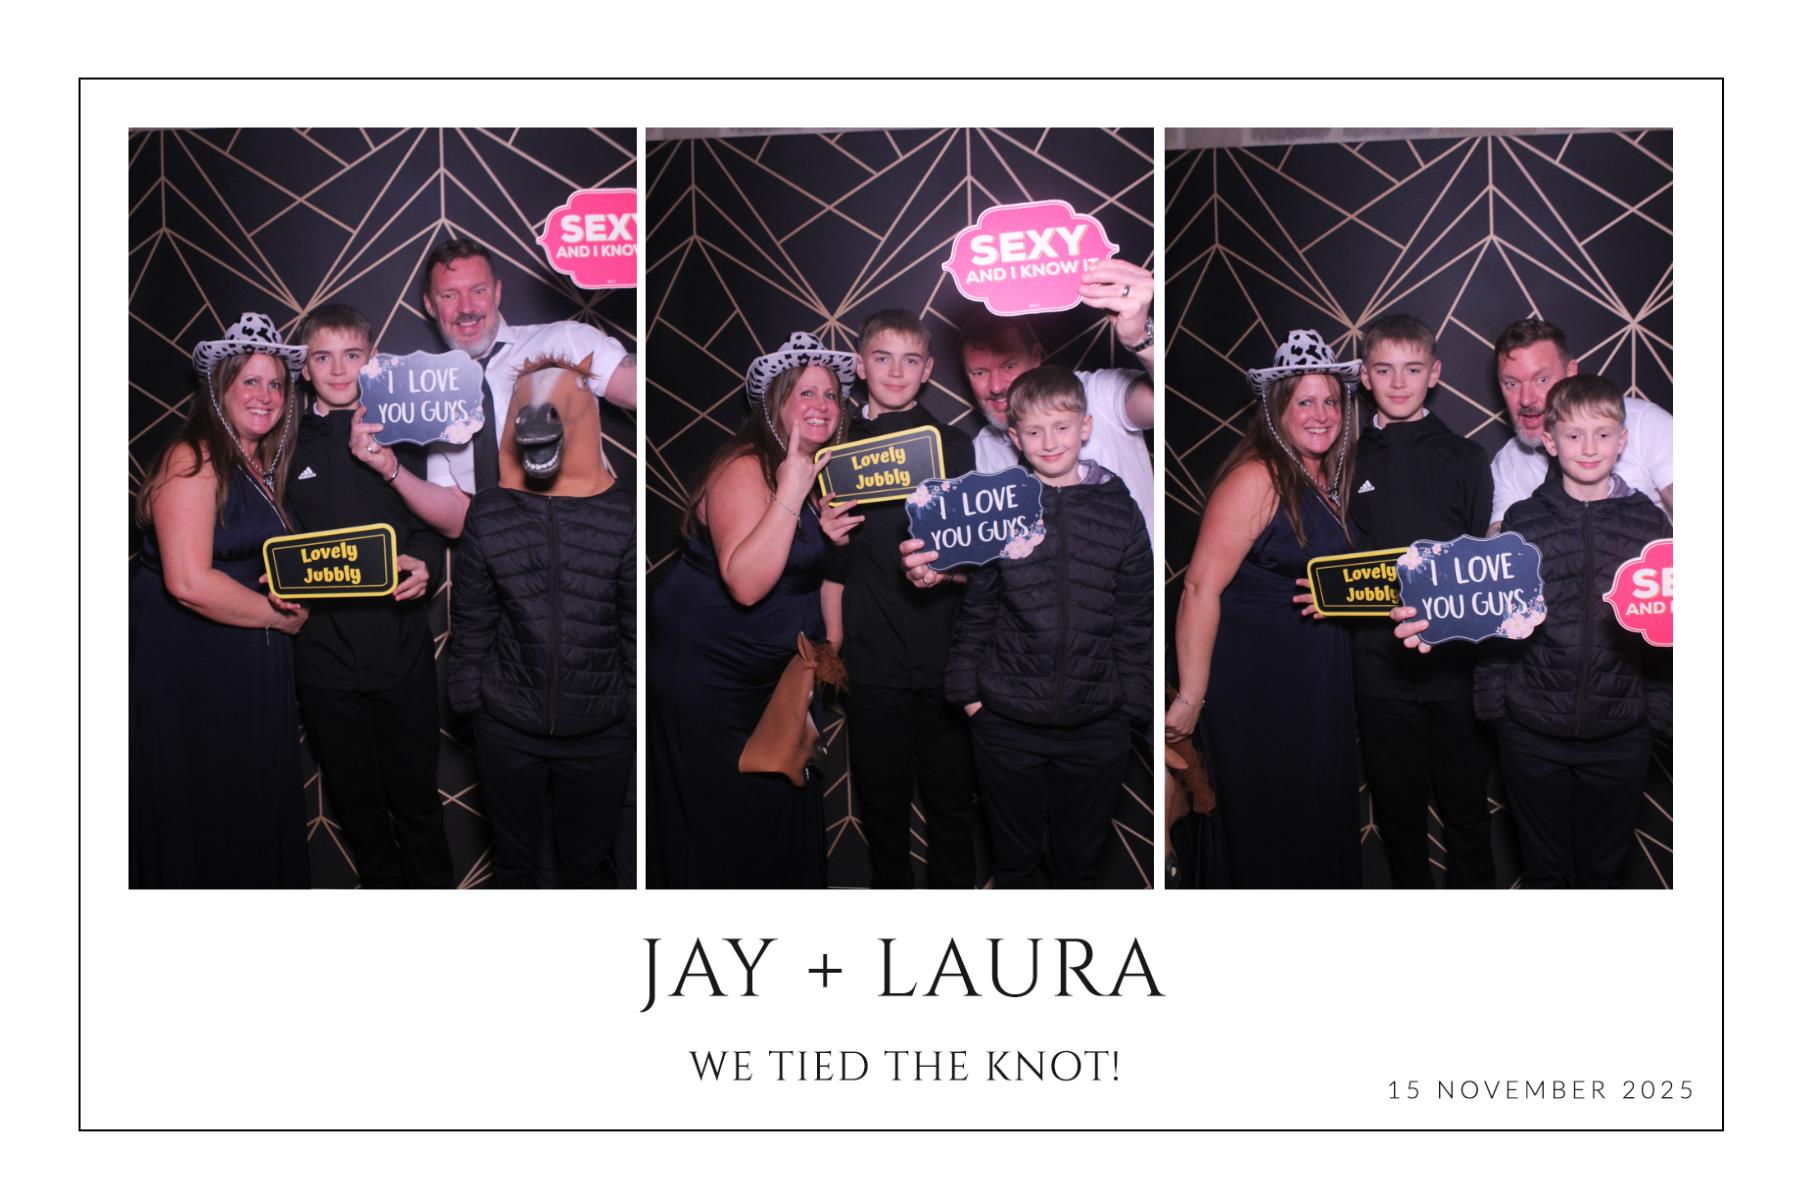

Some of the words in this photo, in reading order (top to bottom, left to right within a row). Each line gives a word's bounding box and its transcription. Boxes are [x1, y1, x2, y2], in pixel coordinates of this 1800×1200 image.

[556, 245, 590, 258] AND
[593, 245, 598, 257] I
[602, 244, 637, 257] KNO
[970, 224, 1088, 266] SEXY
[966, 267, 1006, 285] AND
[1011, 265, 1015, 280] I
[1020, 260, 1080, 279] KNOW
[388, 370, 394, 394] I
[409, 367, 460, 394] LOVE
[378, 402, 416, 424] YOU
[421, 399, 469, 423] GUYS
[851, 446, 907, 471] Lovely
[855, 467, 911, 490] Jubbly
[939, 495, 947, 520] I
[962, 484, 1019, 516] LOVE
[930, 524, 972, 551] YOU
[978, 515, 1030, 543] GUYS
[300, 542, 359, 564] Lovely
[303, 565, 362, 585] Jubbly
[1342, 562, 1397, 583] Lovely
[1430, 559, 1438, 586] I
[1454, 552, 1515, 585] LOVE
[1346, 585, 1399, 604] Jubbly
[1421, 596, 1465, 621] YOU
[1472, 589, 1528, 616] GUYS
[1625, 601, 1666, 616] AND
